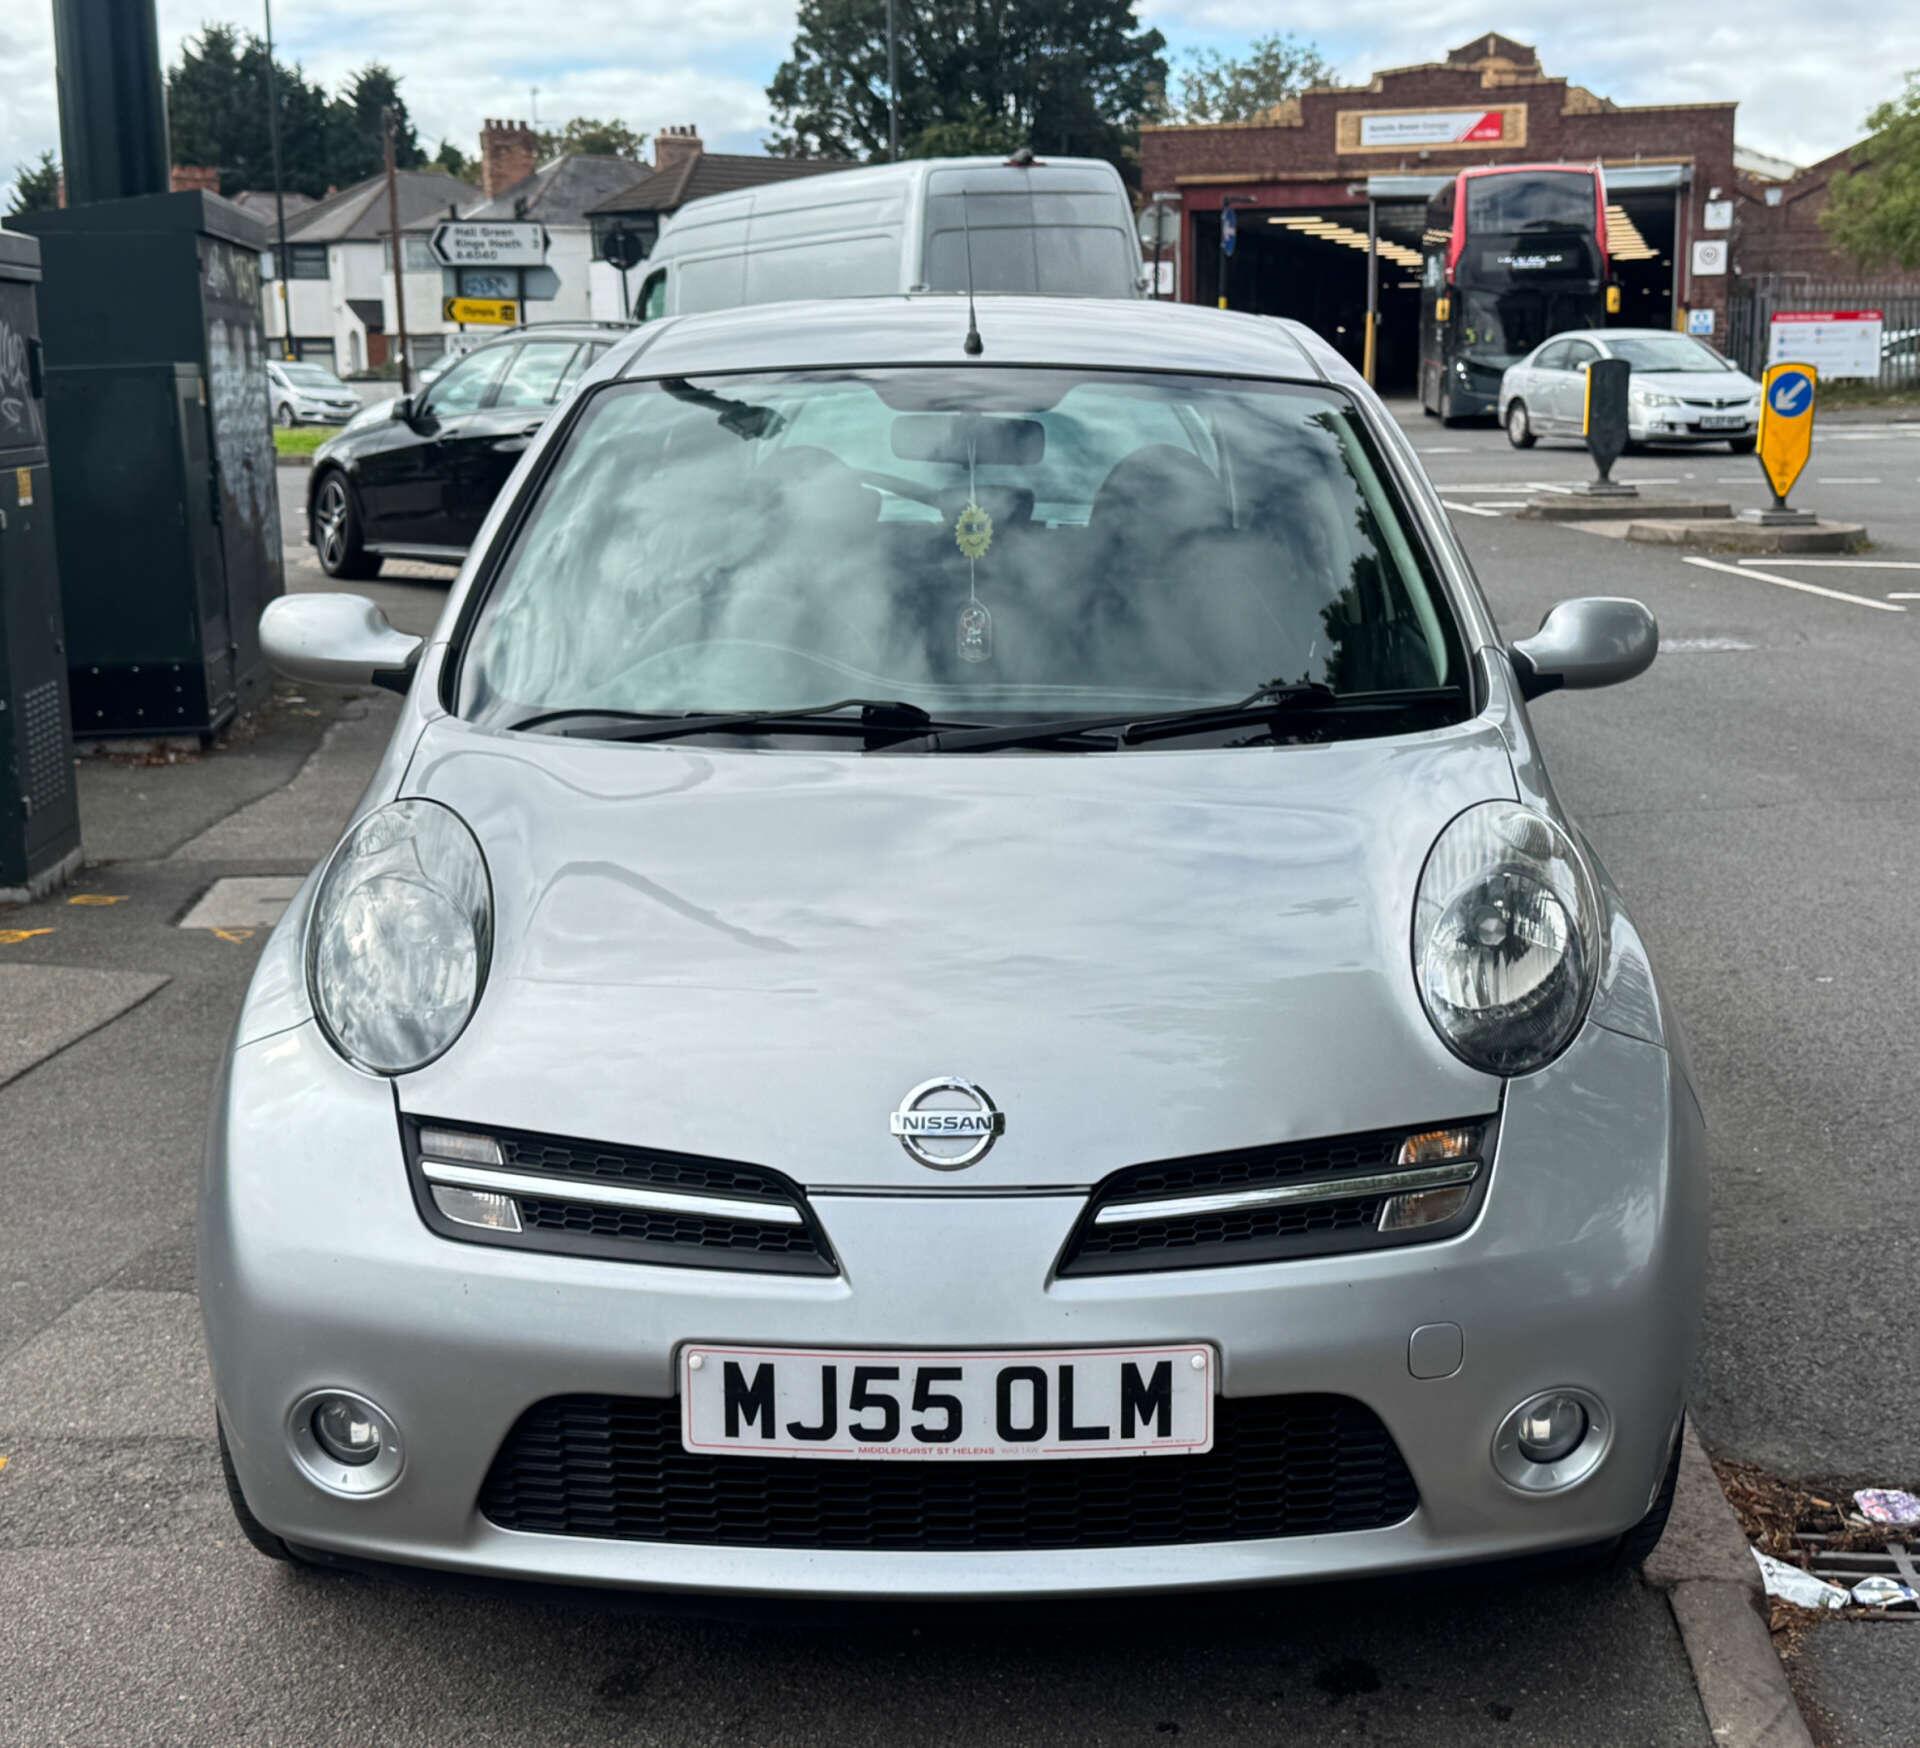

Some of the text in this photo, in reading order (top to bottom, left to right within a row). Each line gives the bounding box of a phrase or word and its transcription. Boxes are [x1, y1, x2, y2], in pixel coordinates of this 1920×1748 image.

[455, 227, 477, 237] Hall
[481, 227, 514, 237] Green
[455, 239, 485, 249] Kings
[488, 239, 522, 249] Heath
[902, 1116, 992, 1130] NISSAN
[723, 1360, 1173, 1443] MJ55 OLM
[857, 1446, 933, 1455] MIDDLEHURST
[936, 1446, 949, 1455] ST
[953, 1446, 995, 1455] HELENS
